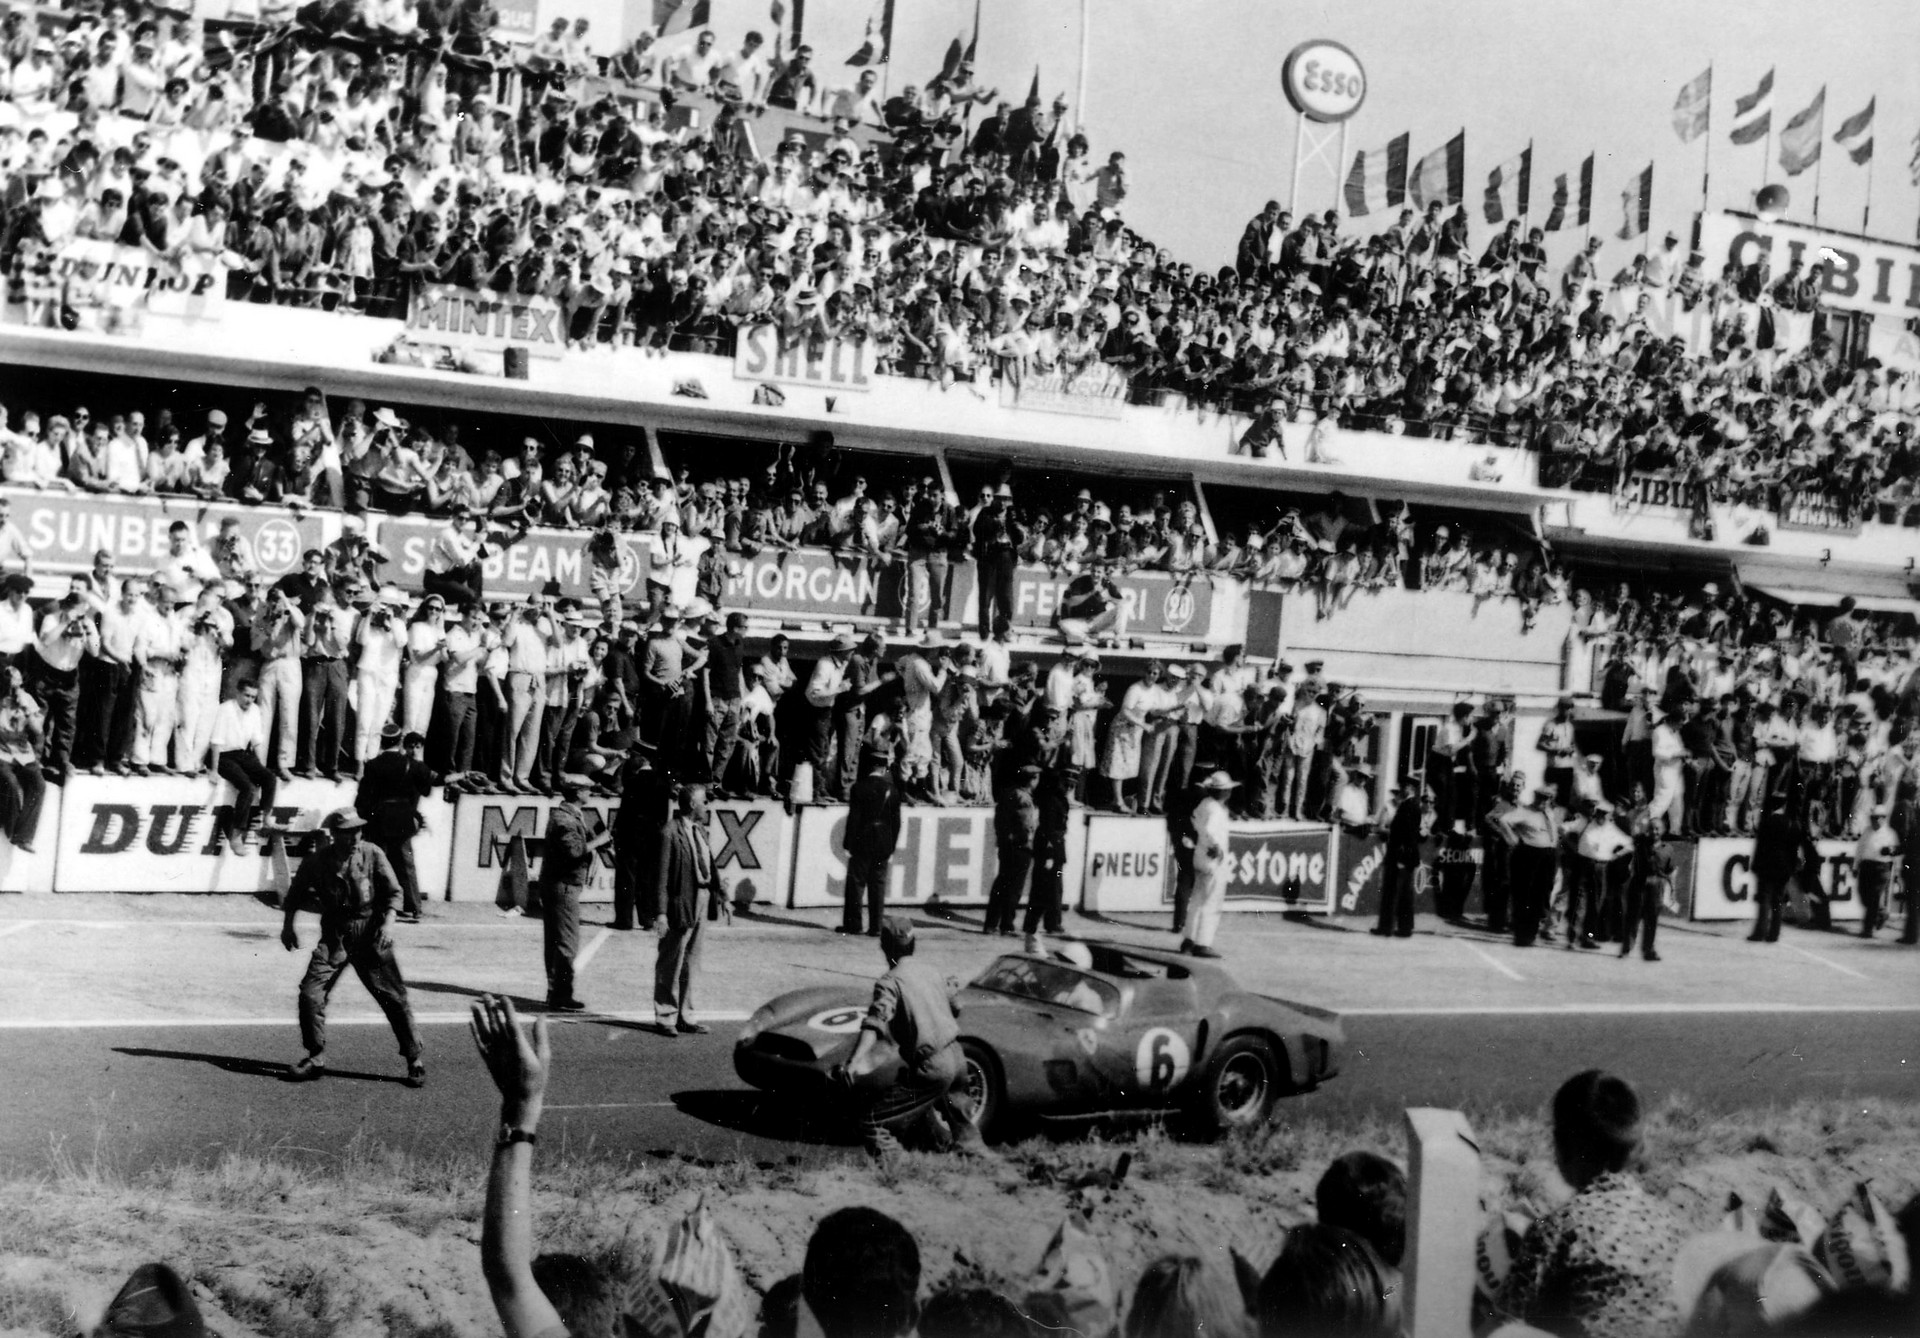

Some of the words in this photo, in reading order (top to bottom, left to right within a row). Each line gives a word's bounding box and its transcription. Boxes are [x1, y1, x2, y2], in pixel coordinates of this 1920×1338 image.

[418, 295, 557, 344] MINTEX
[28, 508, 219, 556] SUNBE
[261, 530, 294, 563] 33
[401, 536, 583, 585] SBEAM
[728, 560, 881, 604] MORGAN
[1017, 581, 1148, 620] FERI
[1092, 853, 1159, 877] PNEUS
[1151, 1033, 1175, 1092] 6
